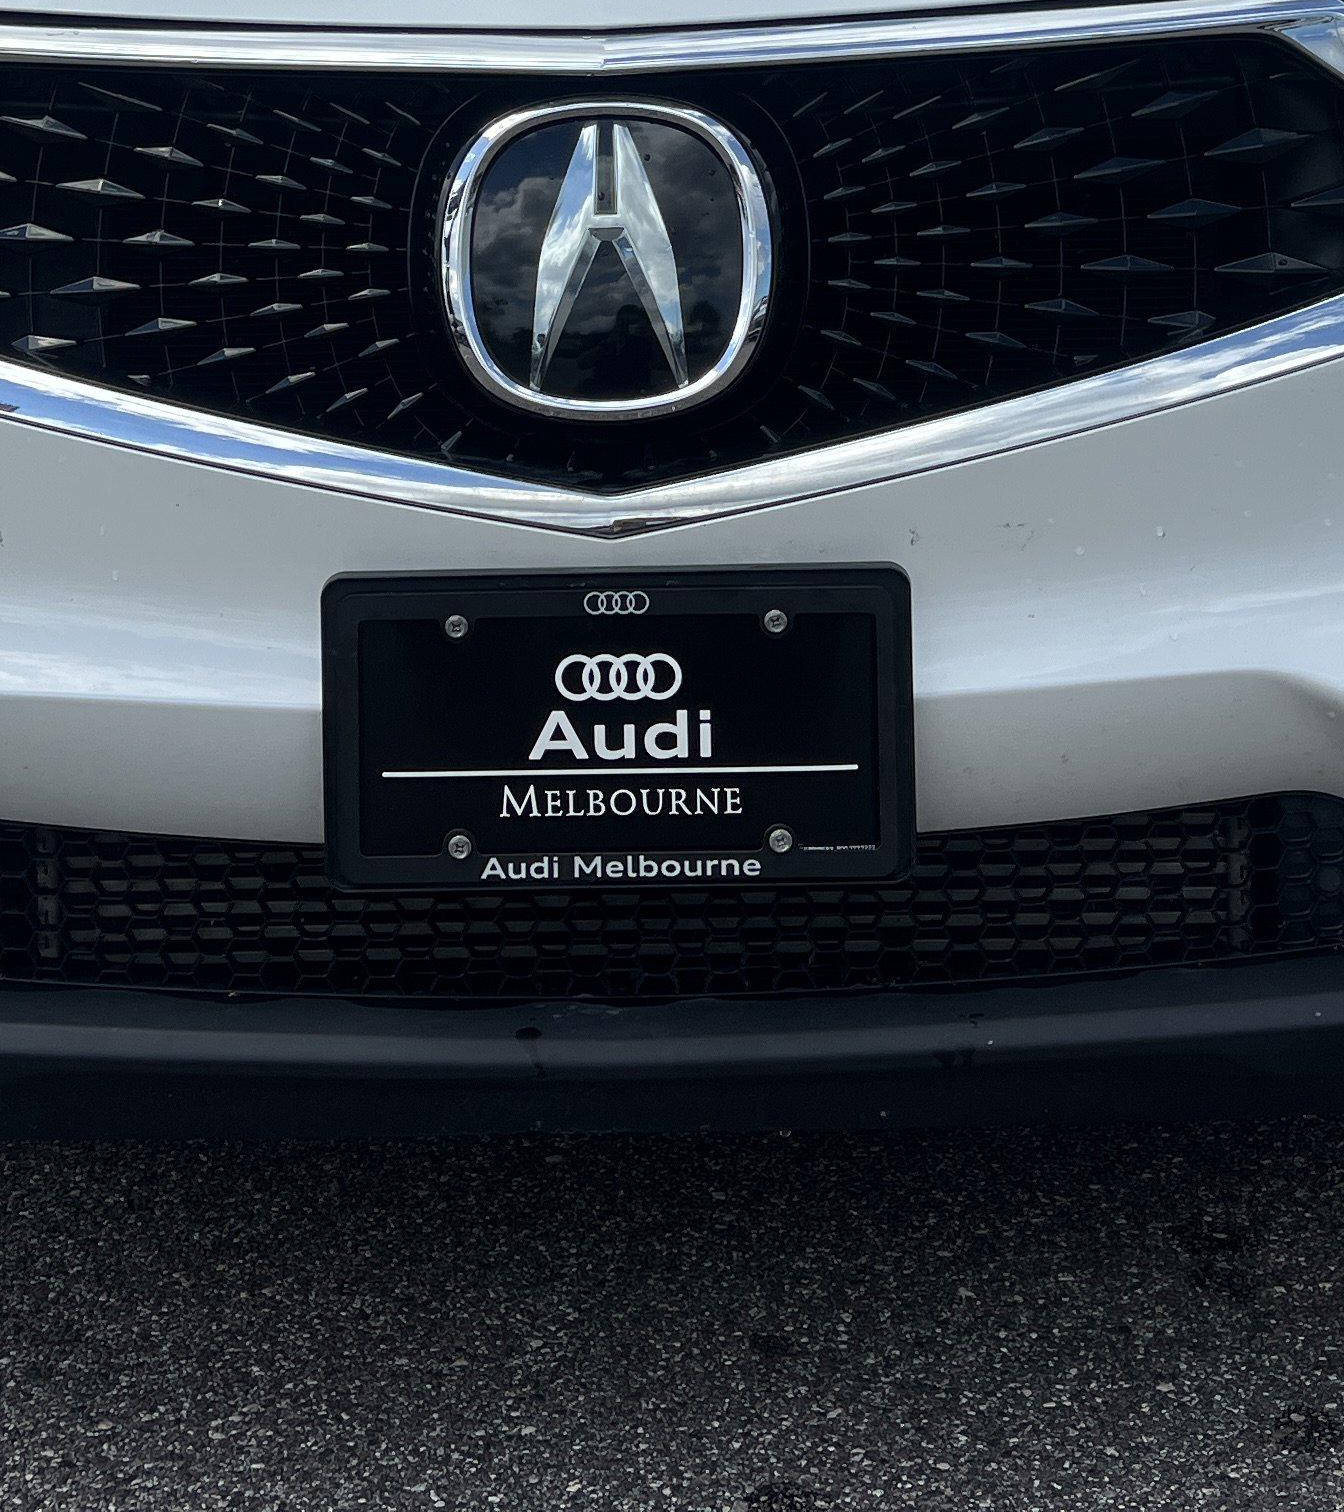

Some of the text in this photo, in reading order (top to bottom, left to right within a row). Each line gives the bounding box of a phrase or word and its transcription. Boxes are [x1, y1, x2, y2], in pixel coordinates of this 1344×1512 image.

[528, 709, 713, 760] Audi
[499, 784, 743, 818] MELBOURNE
[480, 854, 763, 880] Audi Melbourne
